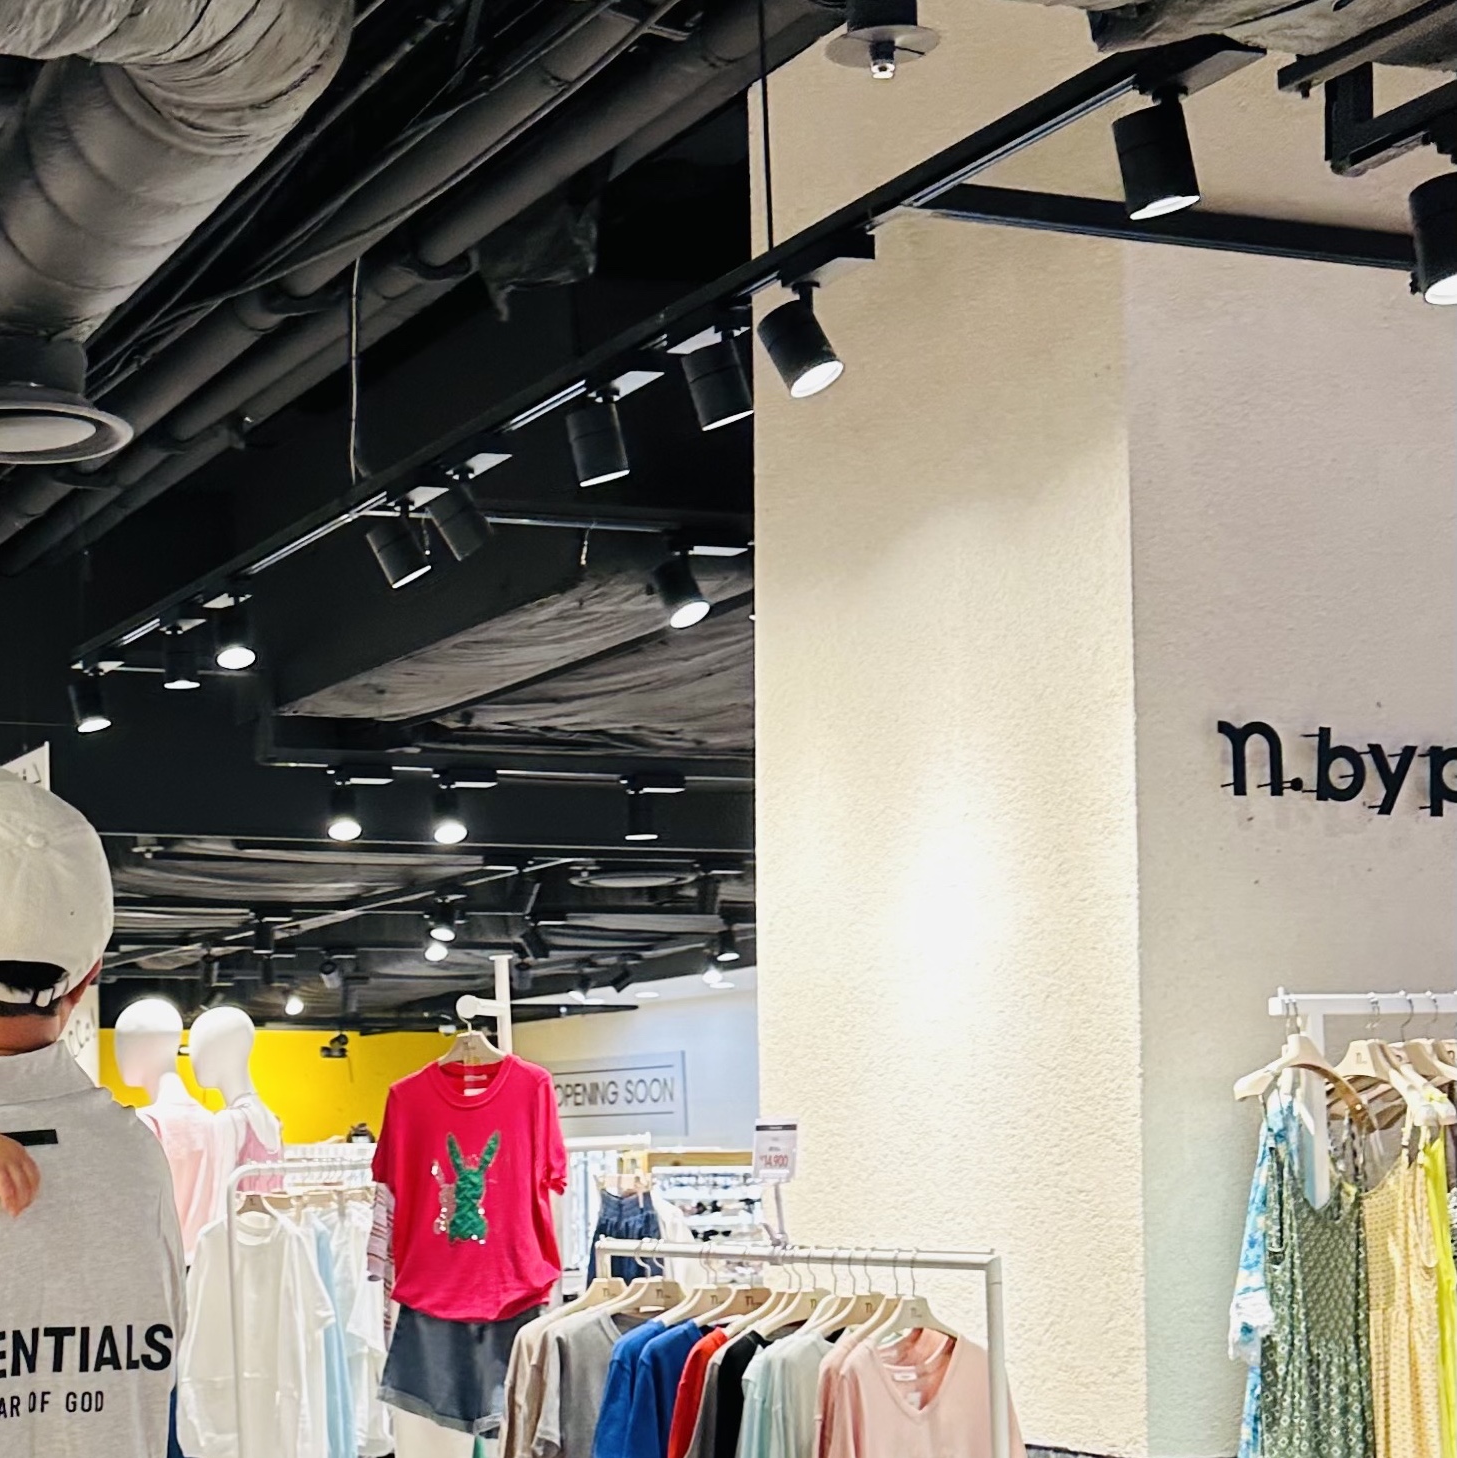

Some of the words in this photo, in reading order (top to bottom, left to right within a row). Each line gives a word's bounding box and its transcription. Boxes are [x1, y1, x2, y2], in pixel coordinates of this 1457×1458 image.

[554, 1080, 619, 1107] OPENING
[624, 1077, 675, 1104] SOON
[28, 1391, 52, 1413] OF
[65, 1390, 105, 1413] GOD
